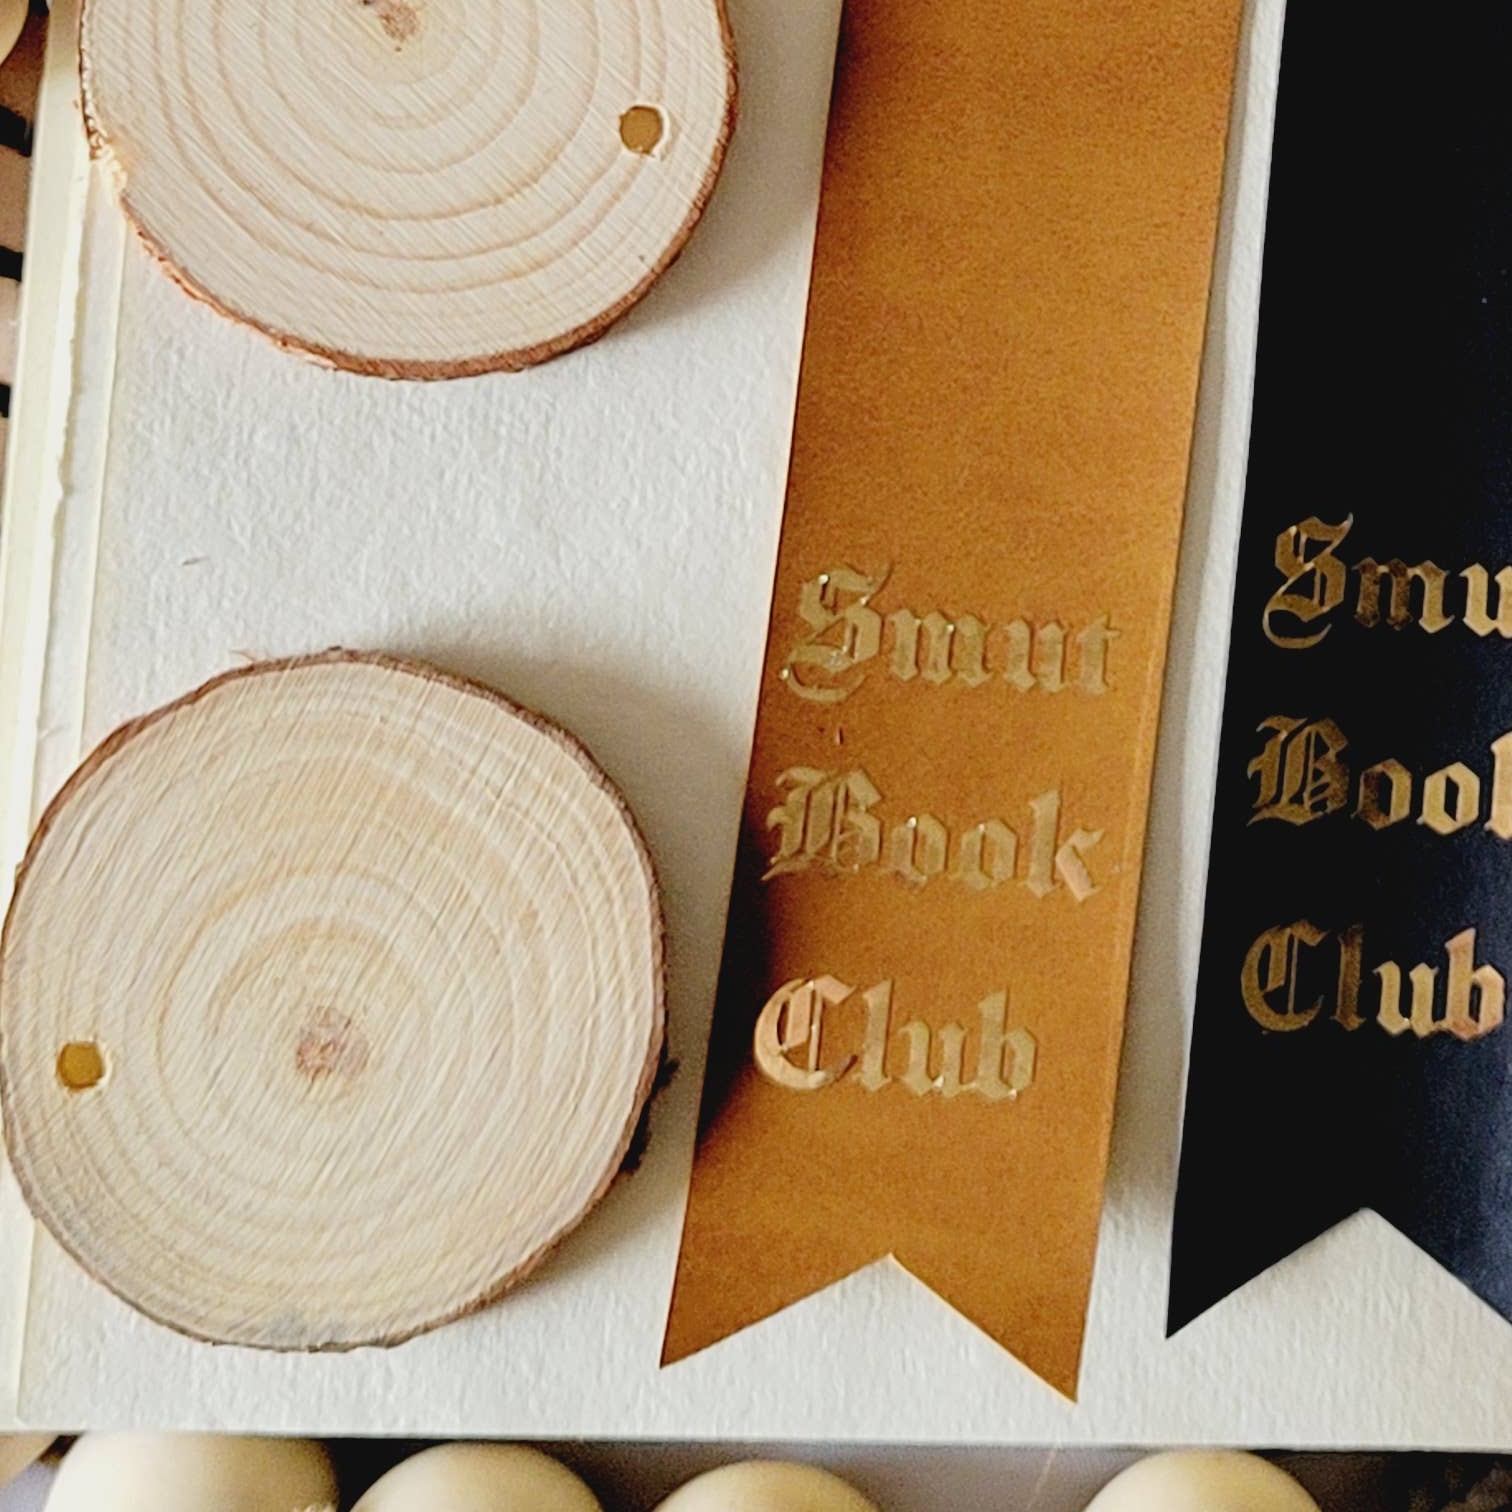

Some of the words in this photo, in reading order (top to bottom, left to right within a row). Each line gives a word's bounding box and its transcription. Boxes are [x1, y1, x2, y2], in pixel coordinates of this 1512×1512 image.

[780, 563, 1122, 702] Smut
[763, 767, 1104, 902] Book
[754, 973, 1037, 1100] Club
[1240, 919, 1506, 1041] Club
